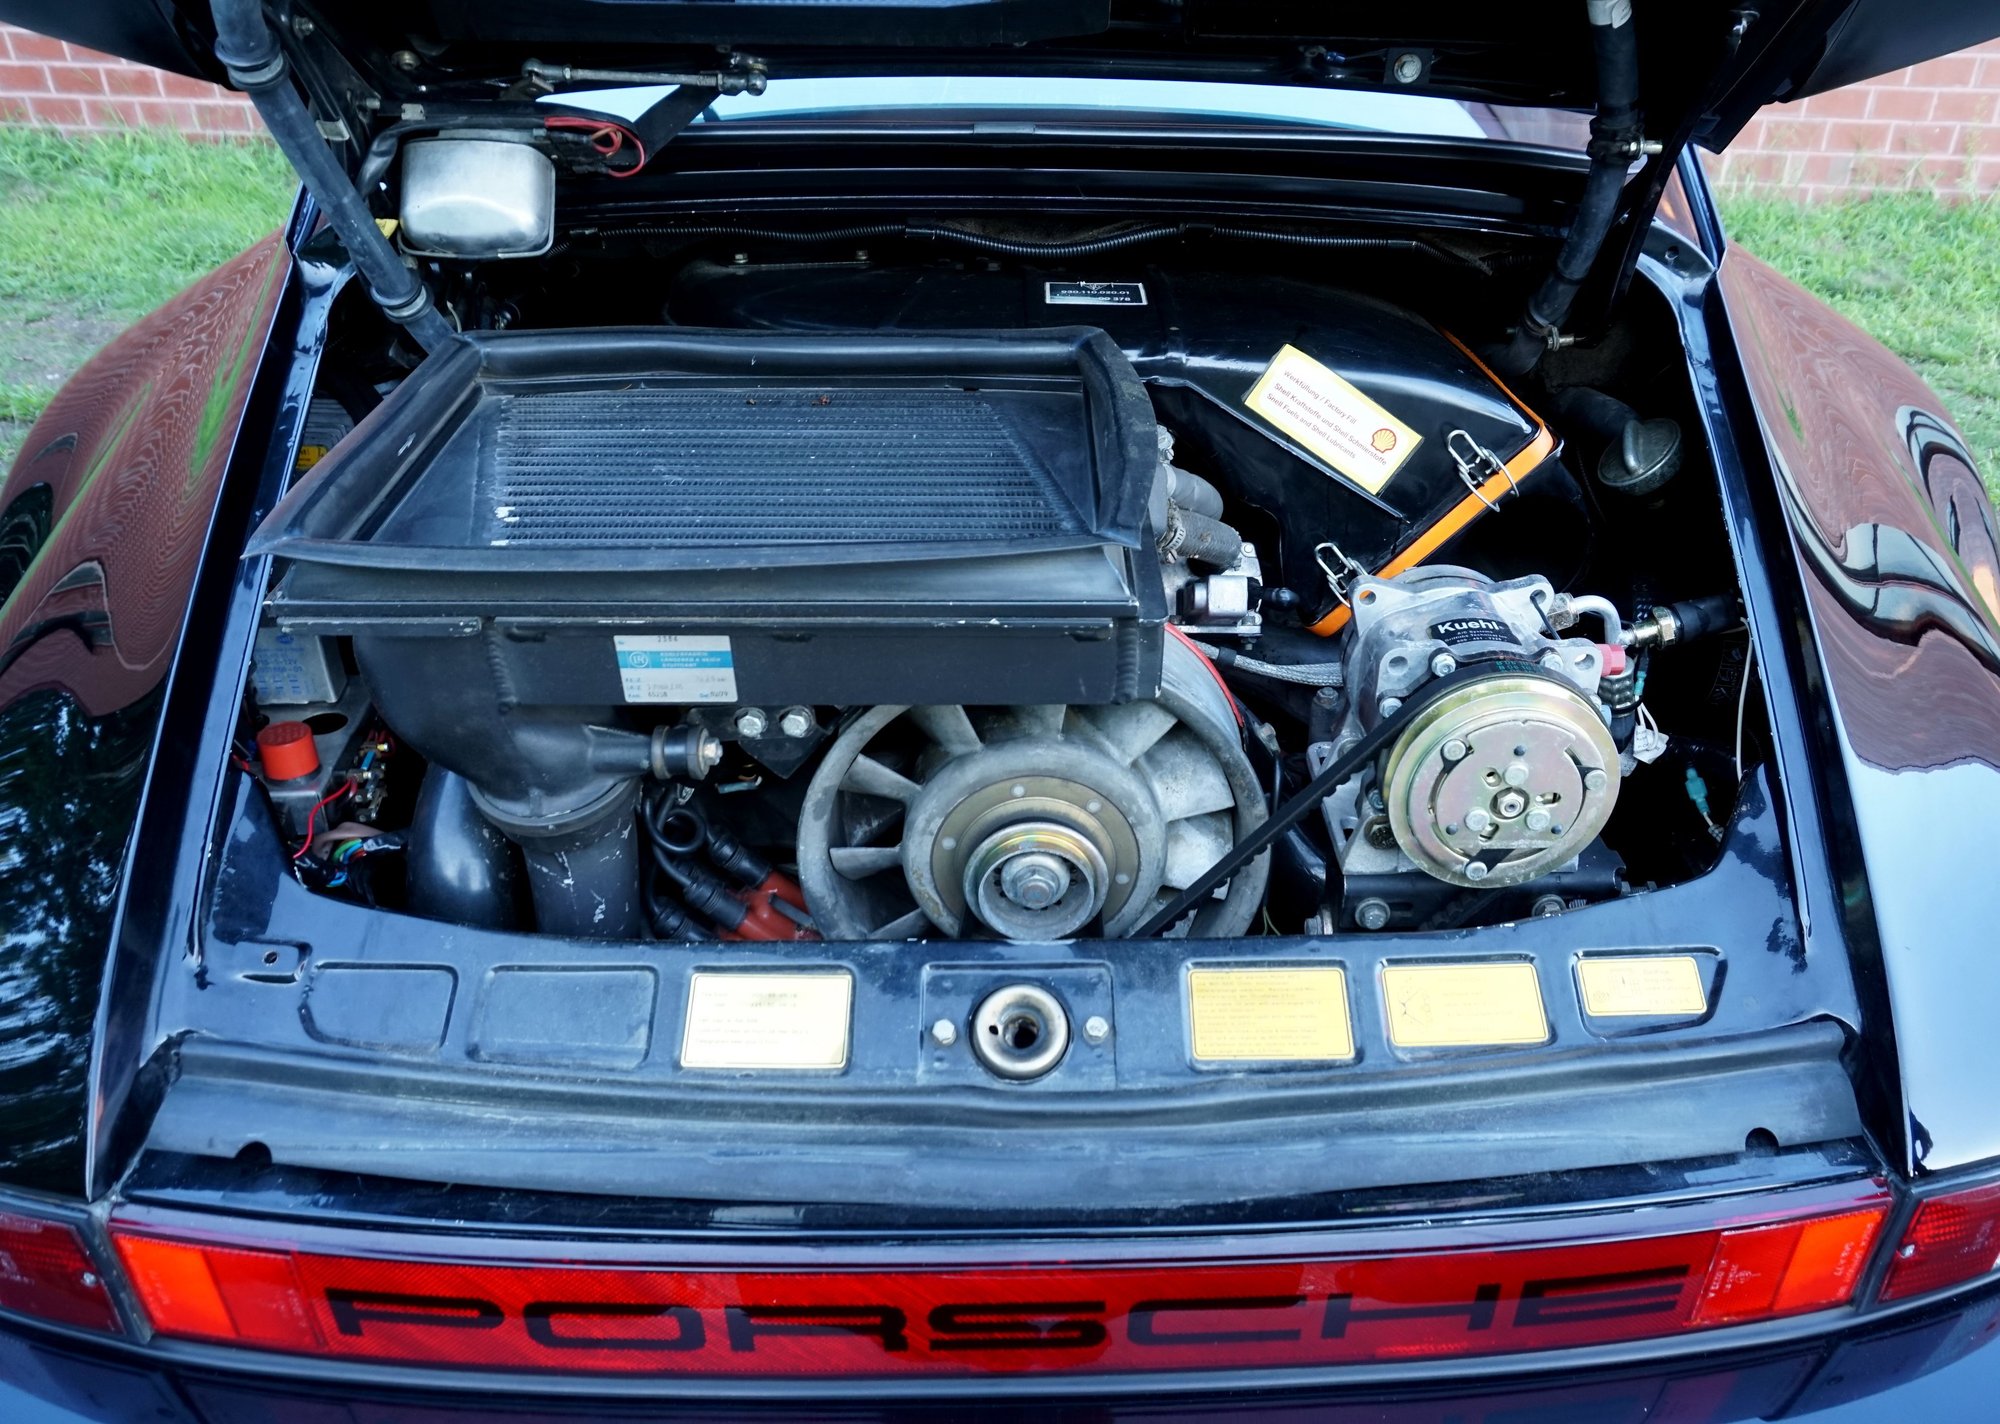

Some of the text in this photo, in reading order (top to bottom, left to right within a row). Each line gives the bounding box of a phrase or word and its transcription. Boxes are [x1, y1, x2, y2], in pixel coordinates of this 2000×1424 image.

[1266, 393, 1357, 460] Shell Fuels and Shell Lubricants
[1274, 382, 1291, 397] Shell
[1290, 393, 1322, 420] Kraftstoffe
[1321, 417, 1334, 429] und
[1334, 424, 1349, 440] Shell
[1324, 399, 1347, 420] Factory
[1347, 413, 1358, 425] Fill
[1437, 619, 1500, 634] Kuehl
[326, 1264, 1691, 1352] PORSCHE
